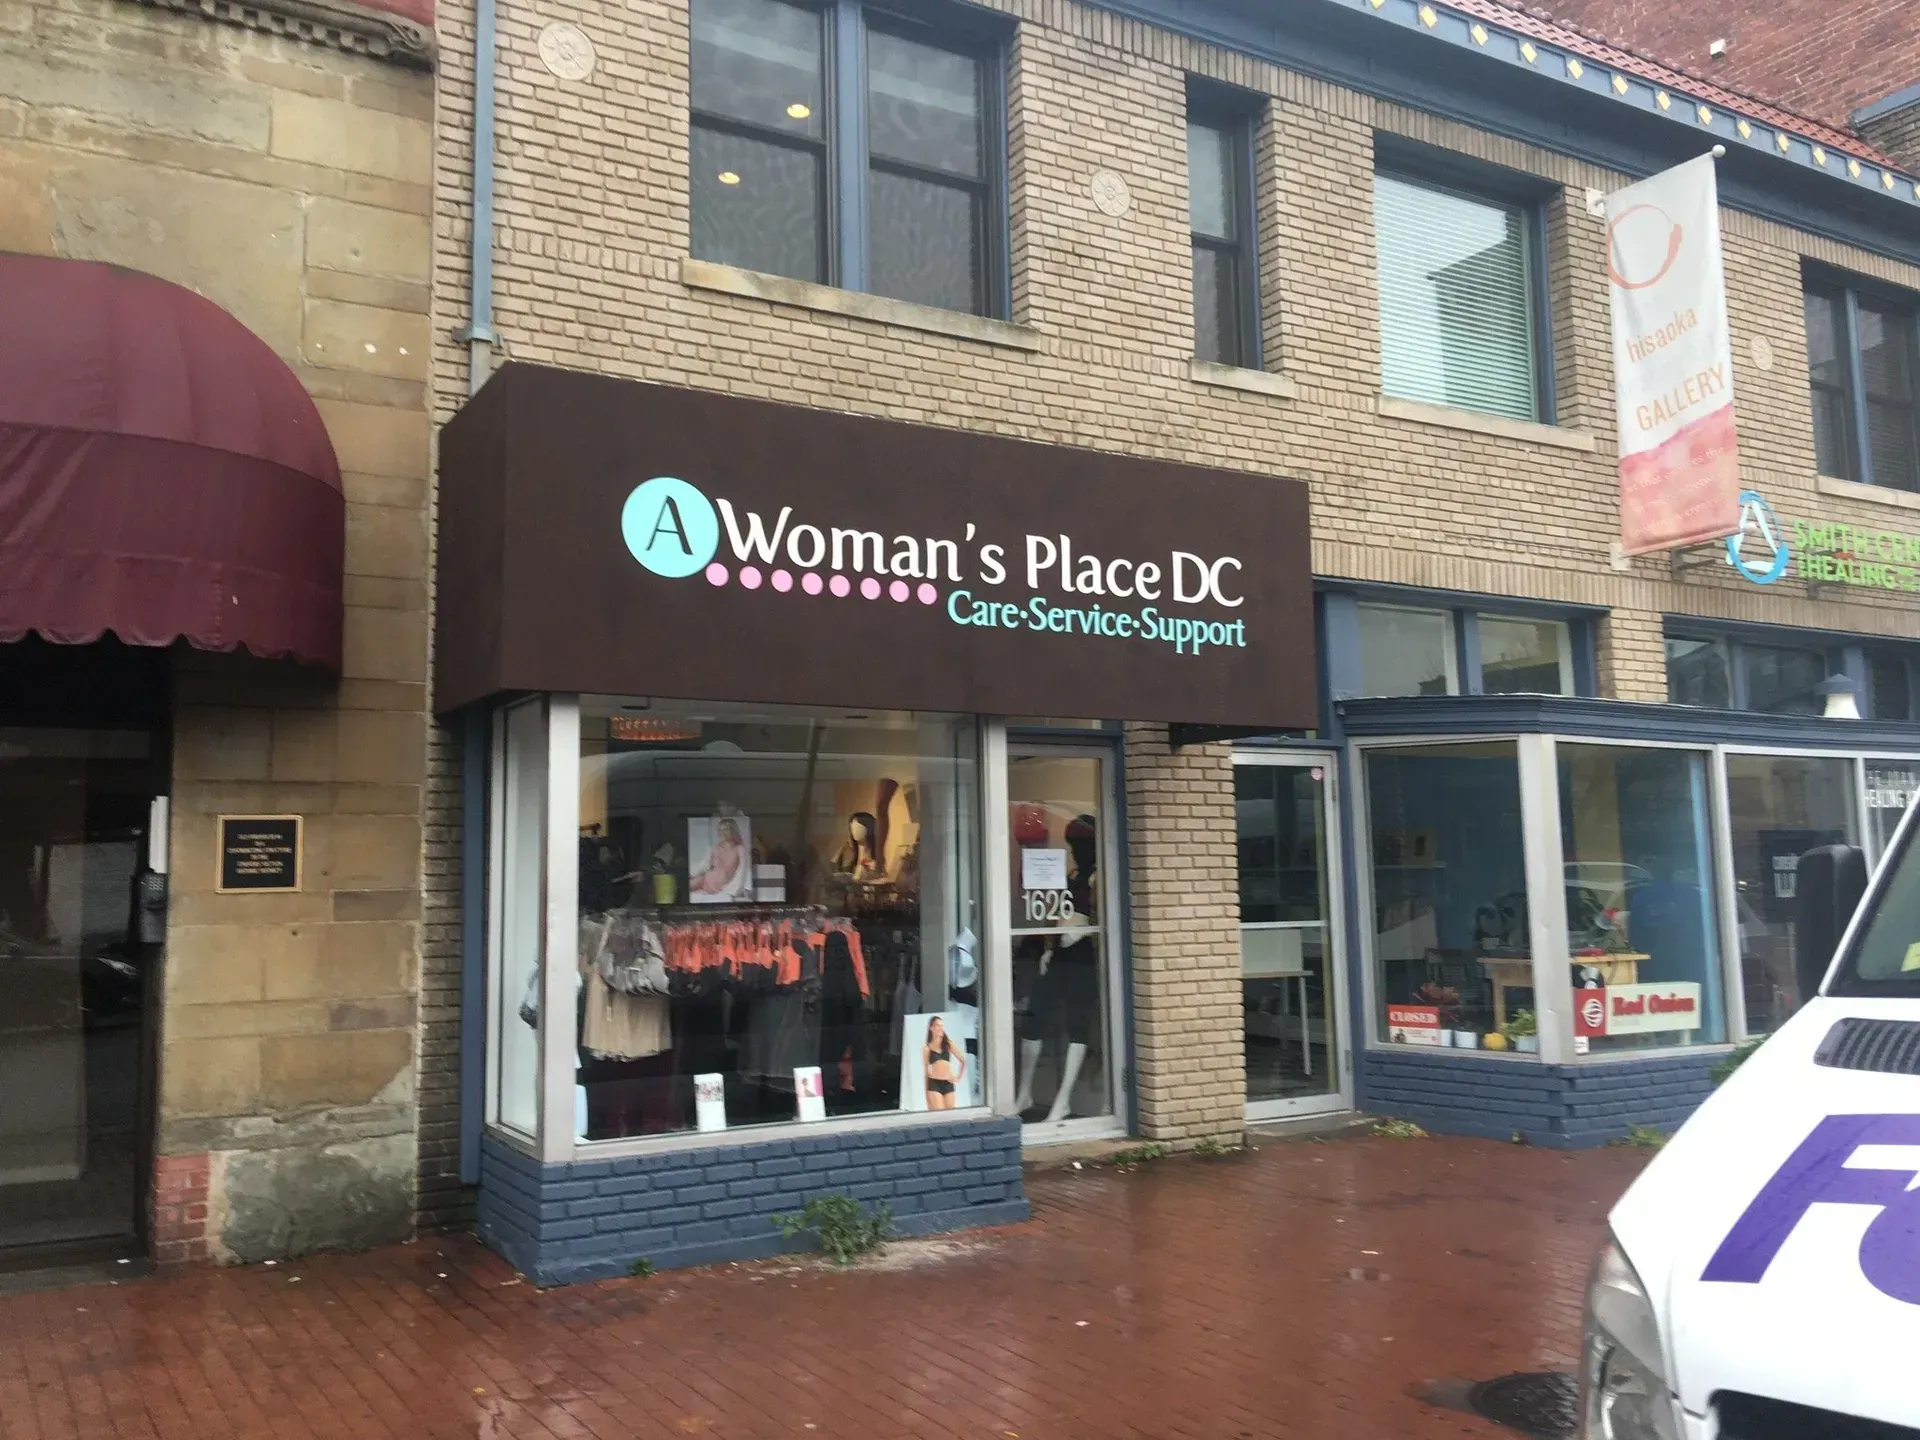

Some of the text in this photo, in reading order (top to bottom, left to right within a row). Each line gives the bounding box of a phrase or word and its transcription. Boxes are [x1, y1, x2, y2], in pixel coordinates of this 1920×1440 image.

[1626, 308, 1698, 364] hisaoka
[1635, 362, 1726, 431] GALLERY
[645, 494, 1245, 609] A Woman's Place DC
[1793, 519, 1868, 557] SMITH
[1807, 553, 1895, 589] HEALING
[1021, 889, 1075, 921] 1626
[1389, 1011, 1438, 1024] CLOSED
[1612, 993, 1695, 1016] Red Onion
